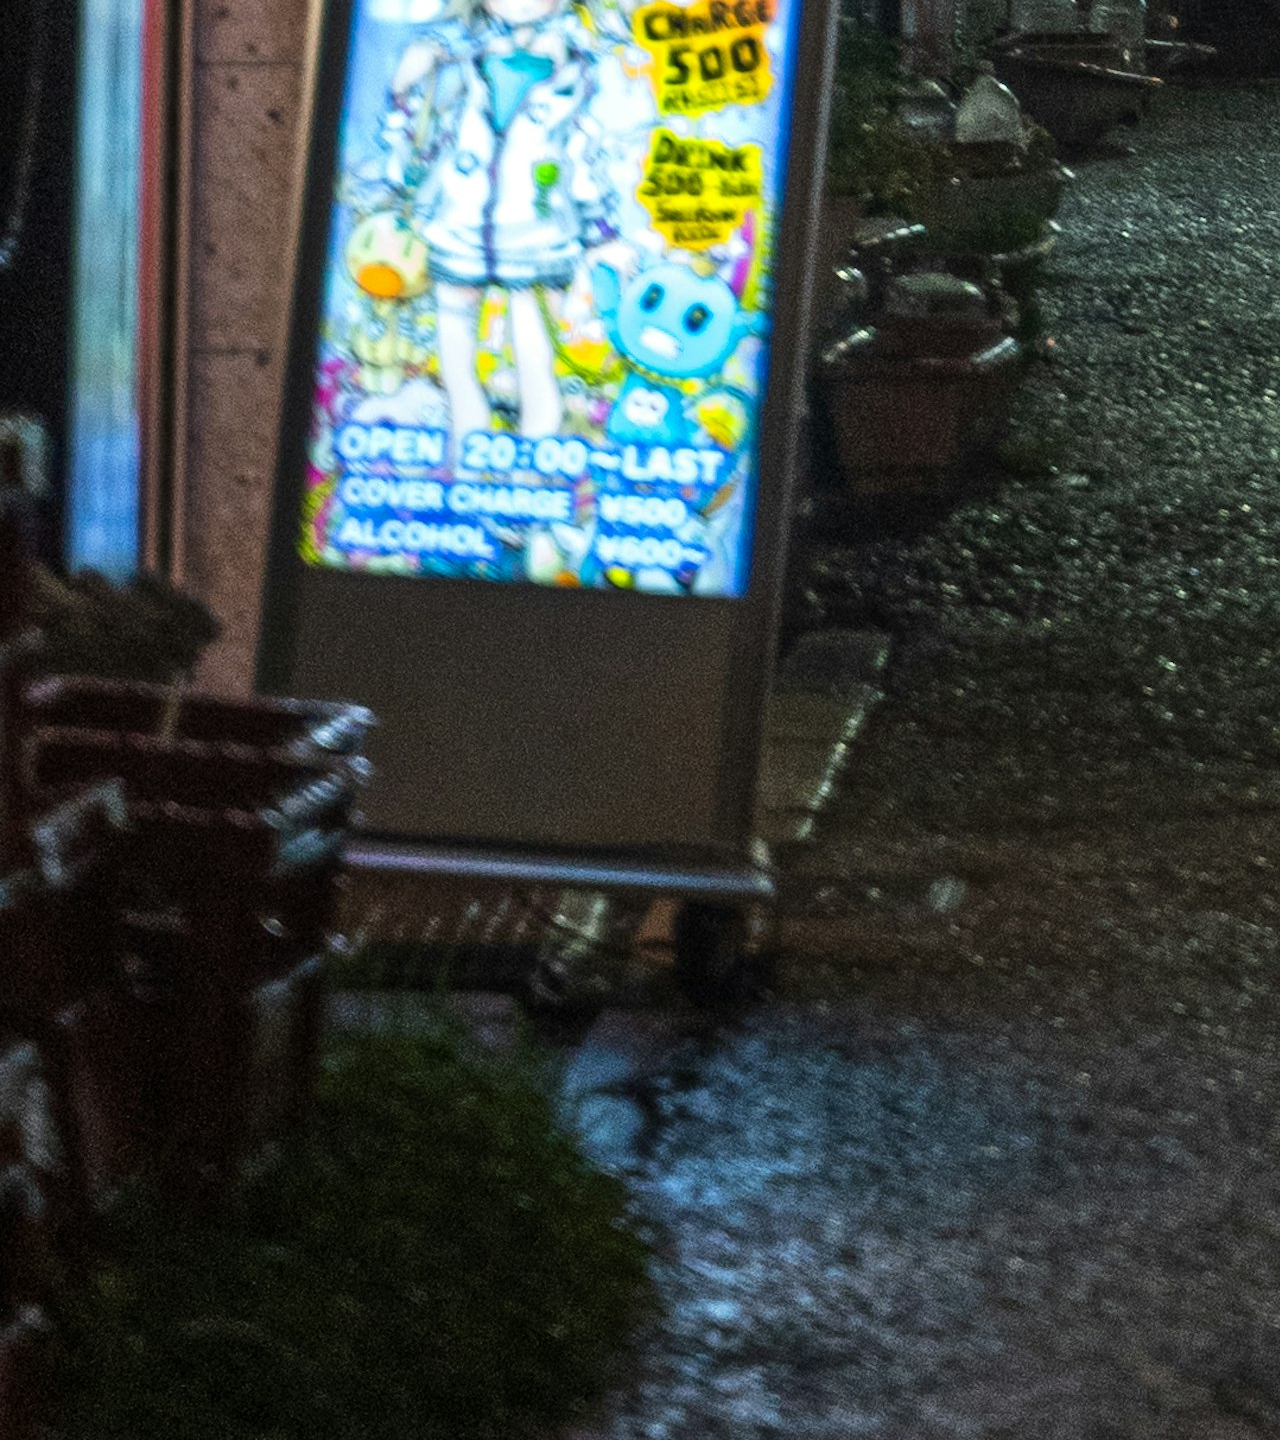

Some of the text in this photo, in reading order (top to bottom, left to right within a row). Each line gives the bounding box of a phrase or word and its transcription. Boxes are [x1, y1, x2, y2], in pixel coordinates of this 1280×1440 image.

[664, 36, 761, 86] 500
[336, 426, 444, 465] OPEN
[340, 476, 444, 512] COVER
[445, 483, 572, 521] CHARGE
[337, 517, 495, 560] ALCOHOL
